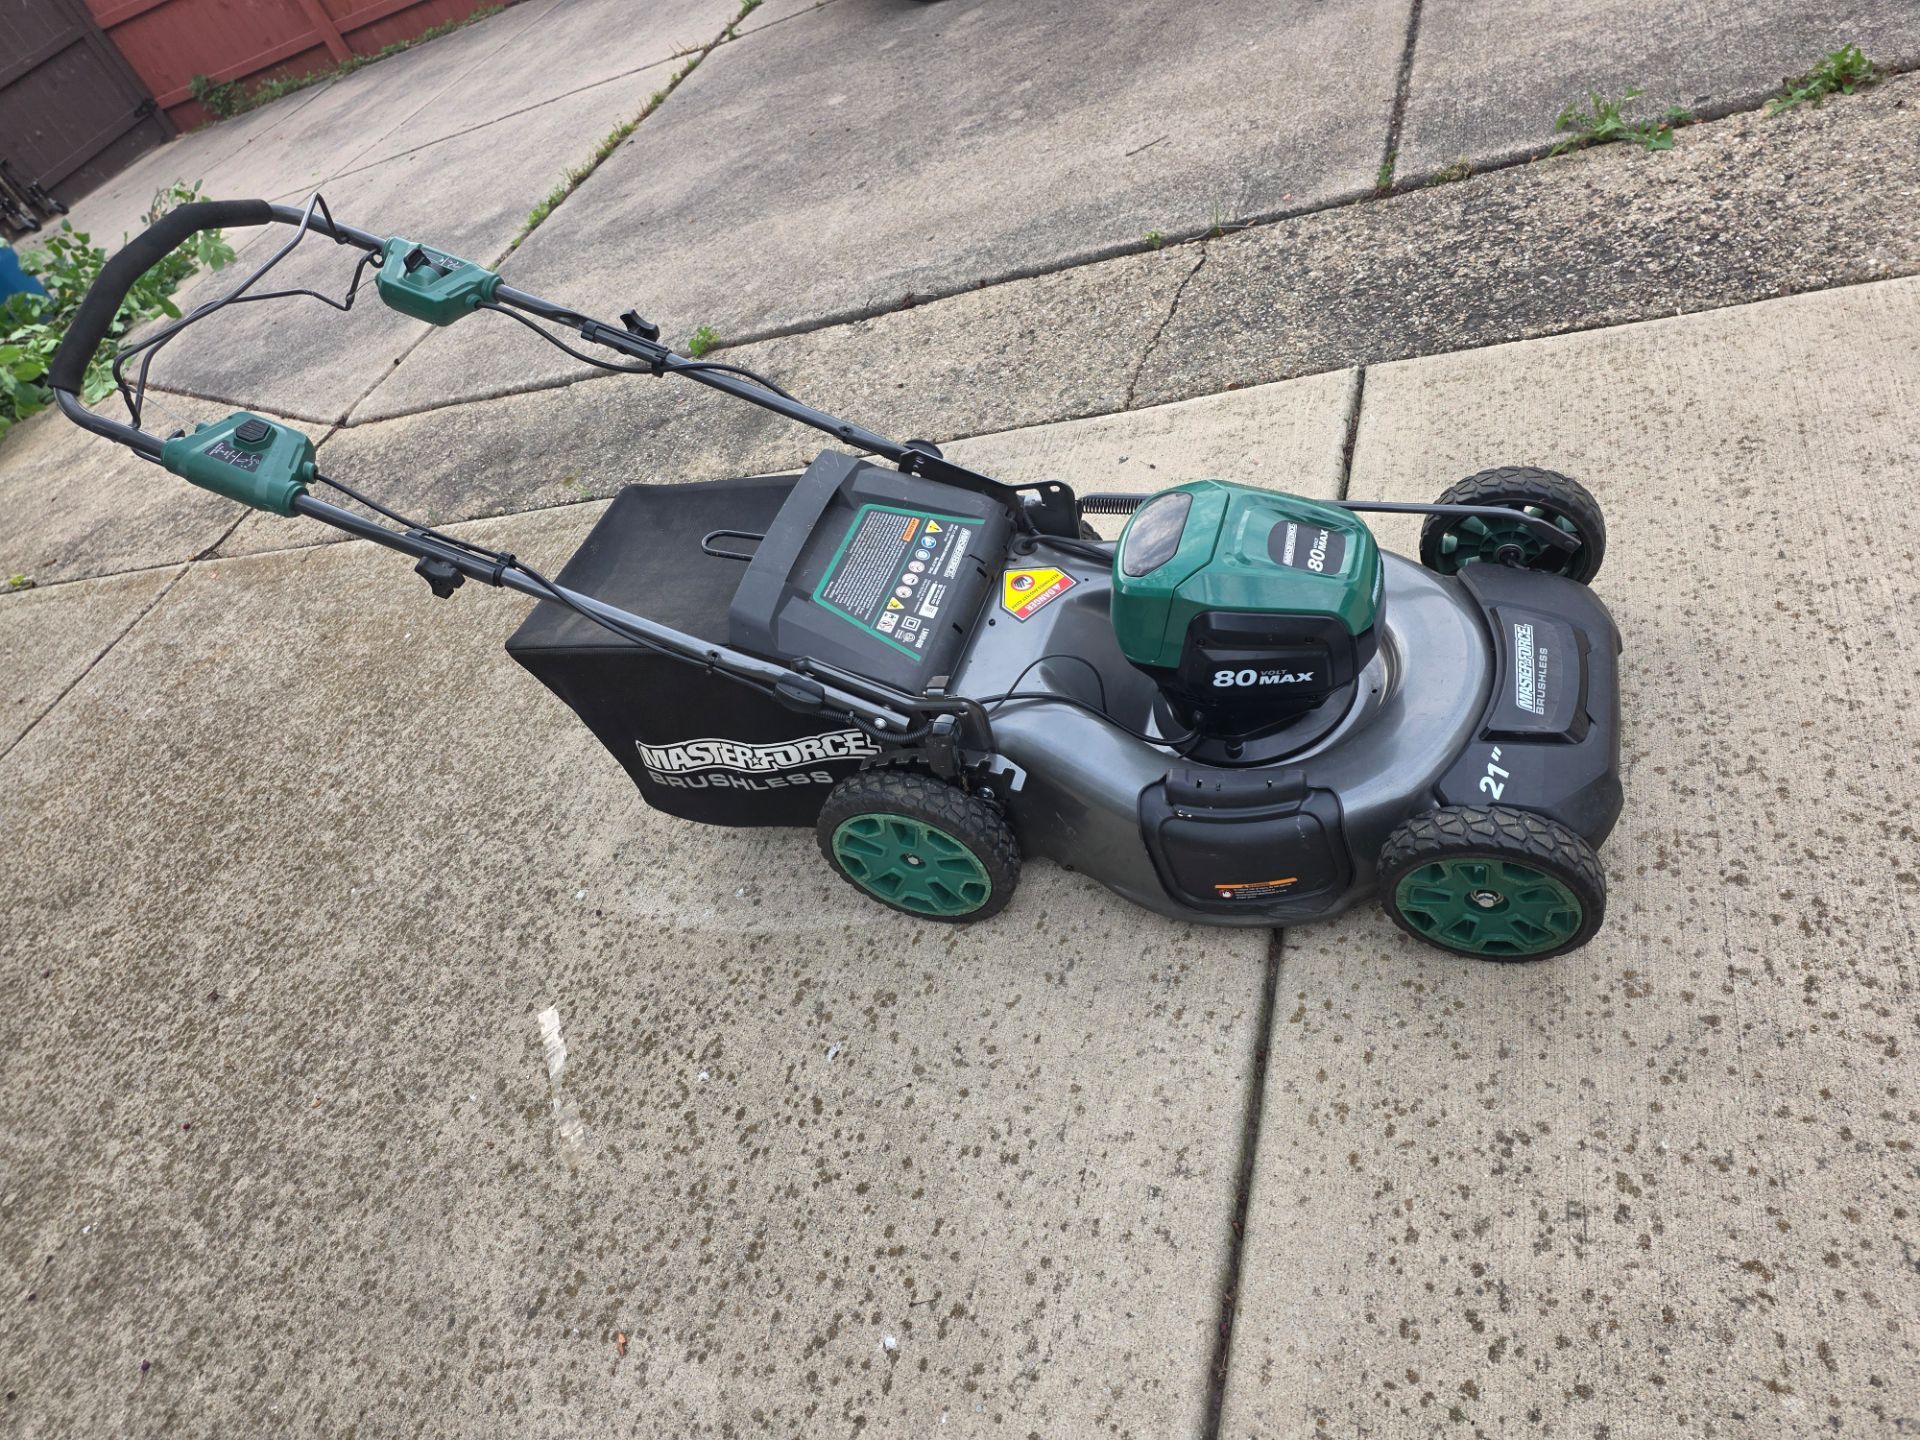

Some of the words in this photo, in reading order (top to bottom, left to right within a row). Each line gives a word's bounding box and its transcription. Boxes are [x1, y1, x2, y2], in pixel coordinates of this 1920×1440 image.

[1318, 528, 1329, 551] MAX
[1307, 548, 1326, 572] 80
[1025, 589, 1056, 611] DANGER
[1212, 669, 1258, 687] 80
[1258, 671, 1315, 686] MAX
[1514, 623, 1535, 714] MASTERFORCE
[1535, 647, 1549, 715] BRUSHLESS
[639, 730, 874, 773] MASTERFORCE
[647, 770, 835, 791] BRUSHLESS
